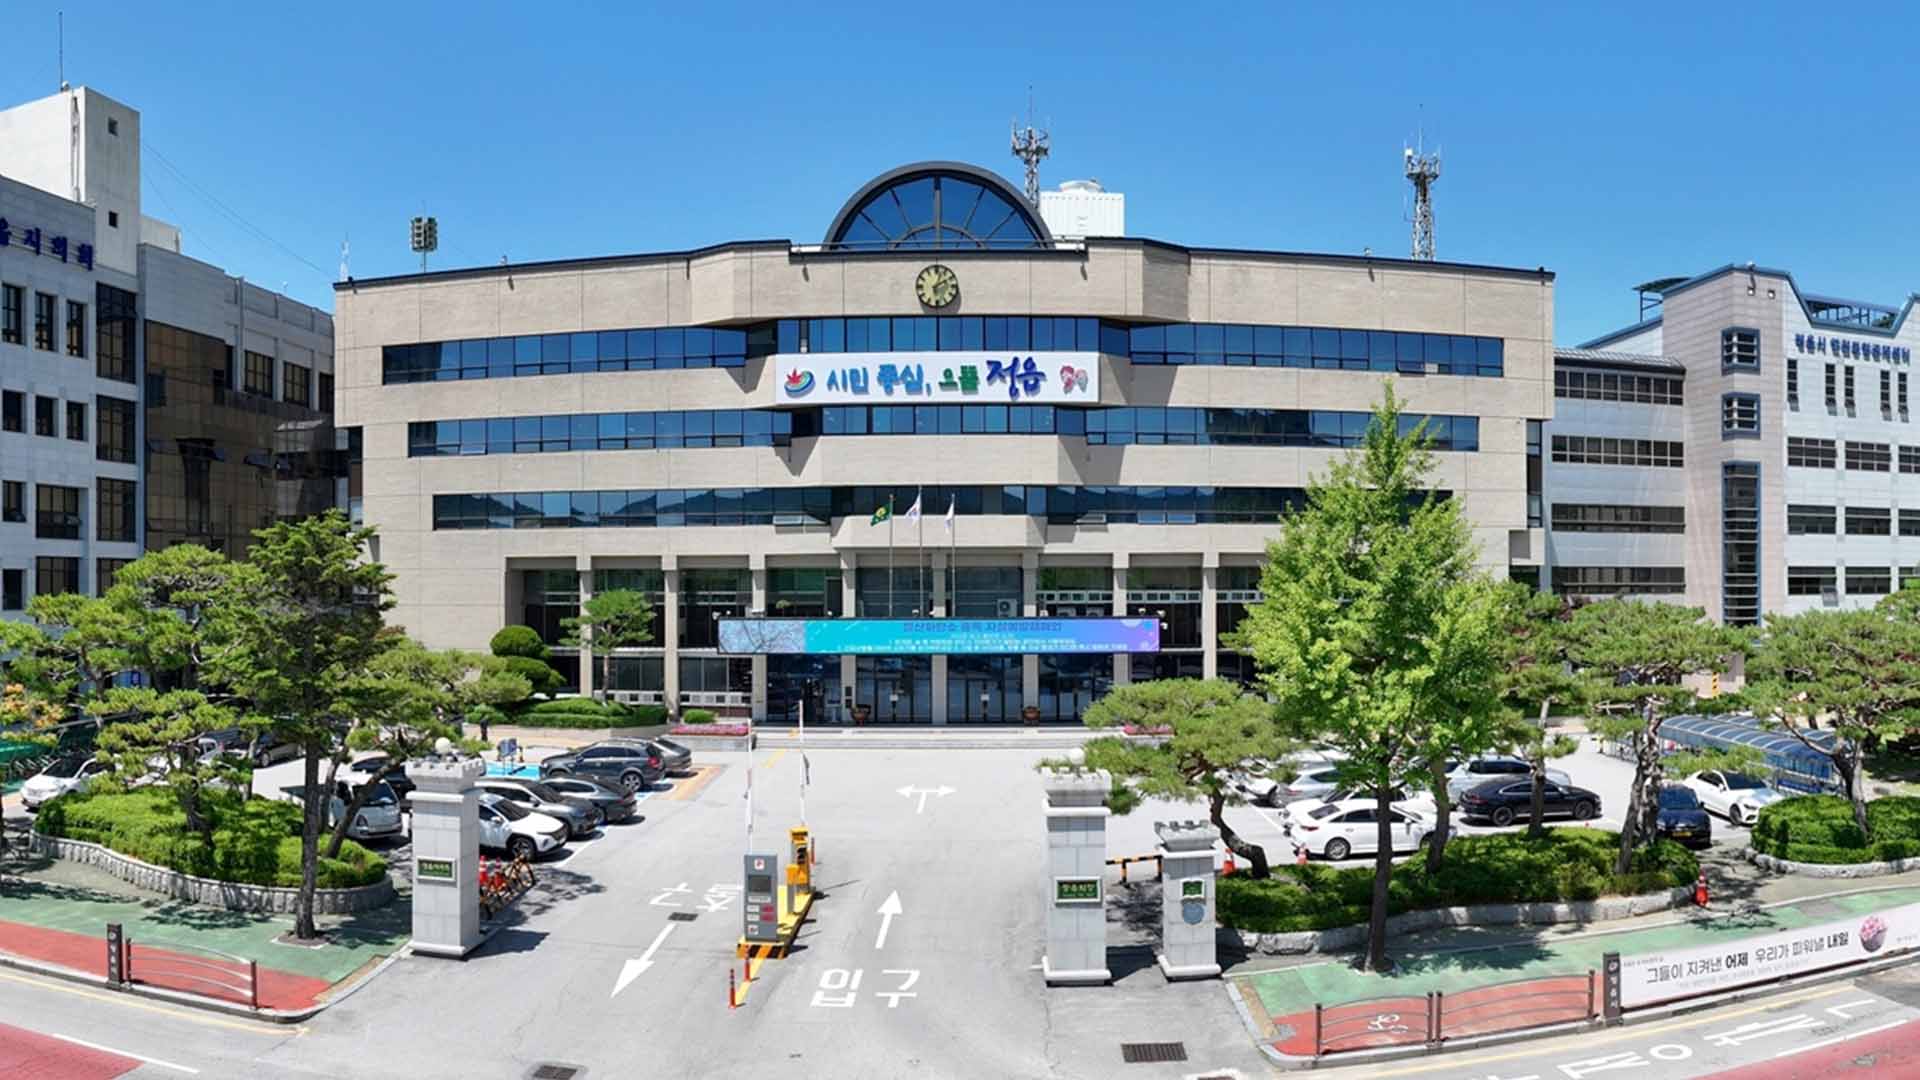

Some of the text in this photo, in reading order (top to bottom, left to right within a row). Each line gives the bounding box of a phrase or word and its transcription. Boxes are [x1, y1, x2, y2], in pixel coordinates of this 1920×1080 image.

[827, 366, 869, 394] 시민
[986, 356, 1047, 399] 정읍
[1646, 963, 1683, 984] 그들이
[1686, 958, 1723, 977] 지켜낸
[1725, 952, 1749, 968] 어제
[1755, 945, 1790, 963] 우리가
[1827, 931, 1849, 948] 내일
[809, 968, 921, 1008] 입구
